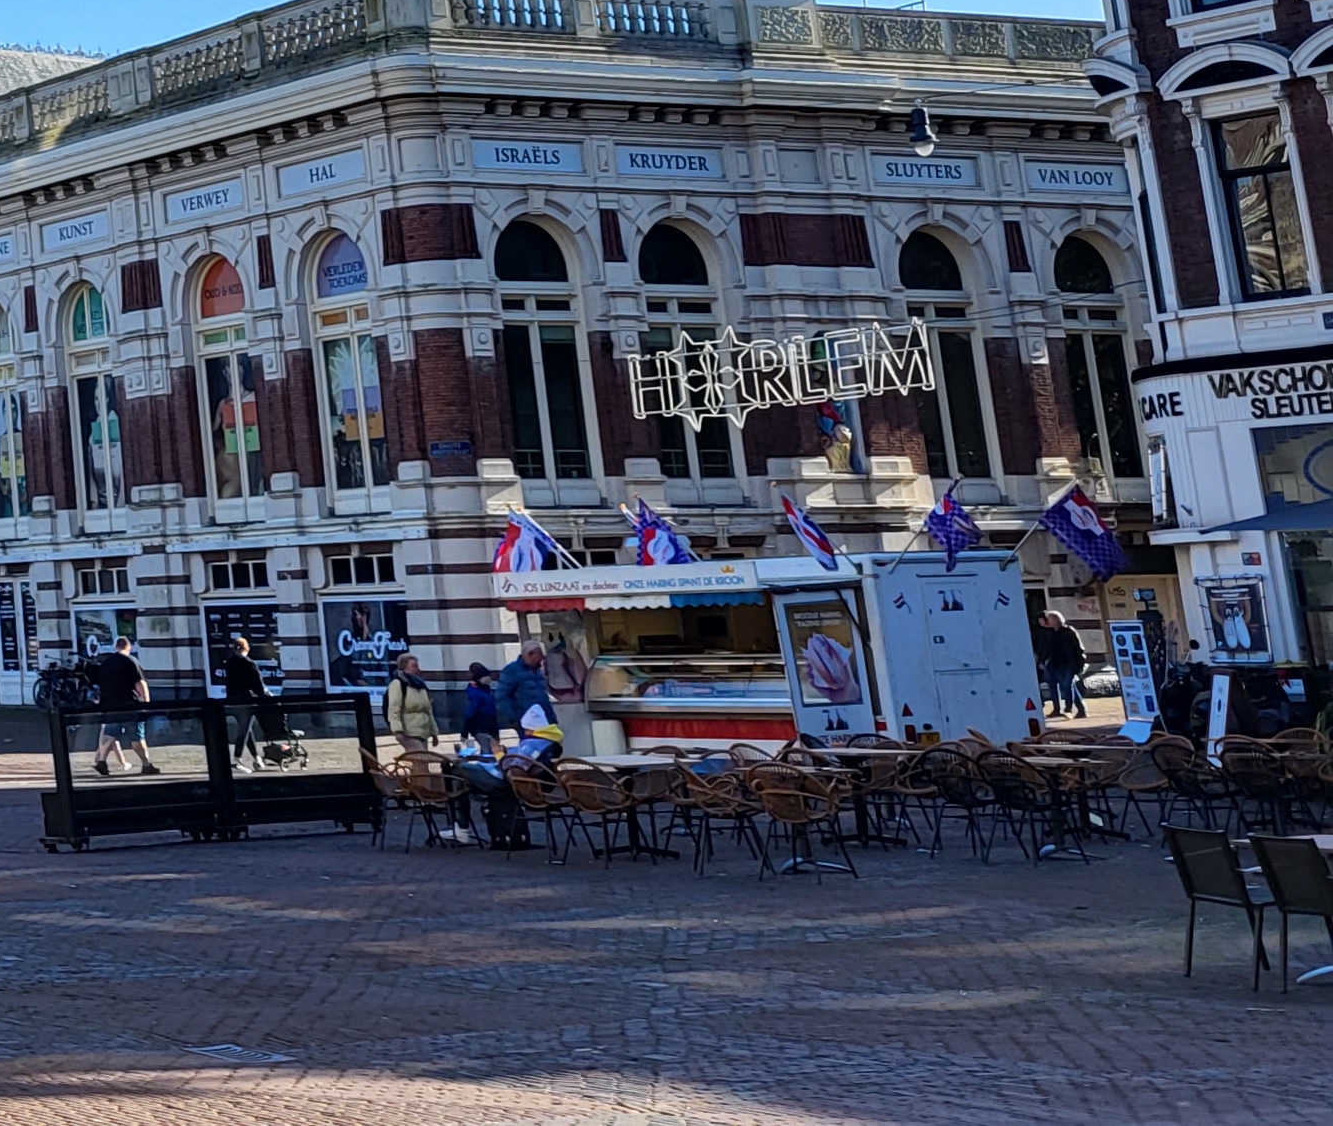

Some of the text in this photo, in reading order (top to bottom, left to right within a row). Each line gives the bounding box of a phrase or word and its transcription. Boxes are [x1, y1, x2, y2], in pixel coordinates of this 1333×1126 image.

[494, 145, 561, 165] ISRAËLS
[628, 153, 709, 171] KRUYDER
[308, 163, 337, 184] HAL
[885, 161, 963, 180] SLUYTERS
[1037, 168, 1115, 186] VAN LOOY
[180, 187, 230, 213] VERWEY
[58, 220, 95, 242] KUNST
[1138, 391, 1185, 423] CARE
[523, 583, 538, 593] JOS
[624, 580, 645, 589] ONZE
[646, 578, 676, 588] HARING
[703, 577, 714, 586] DE
